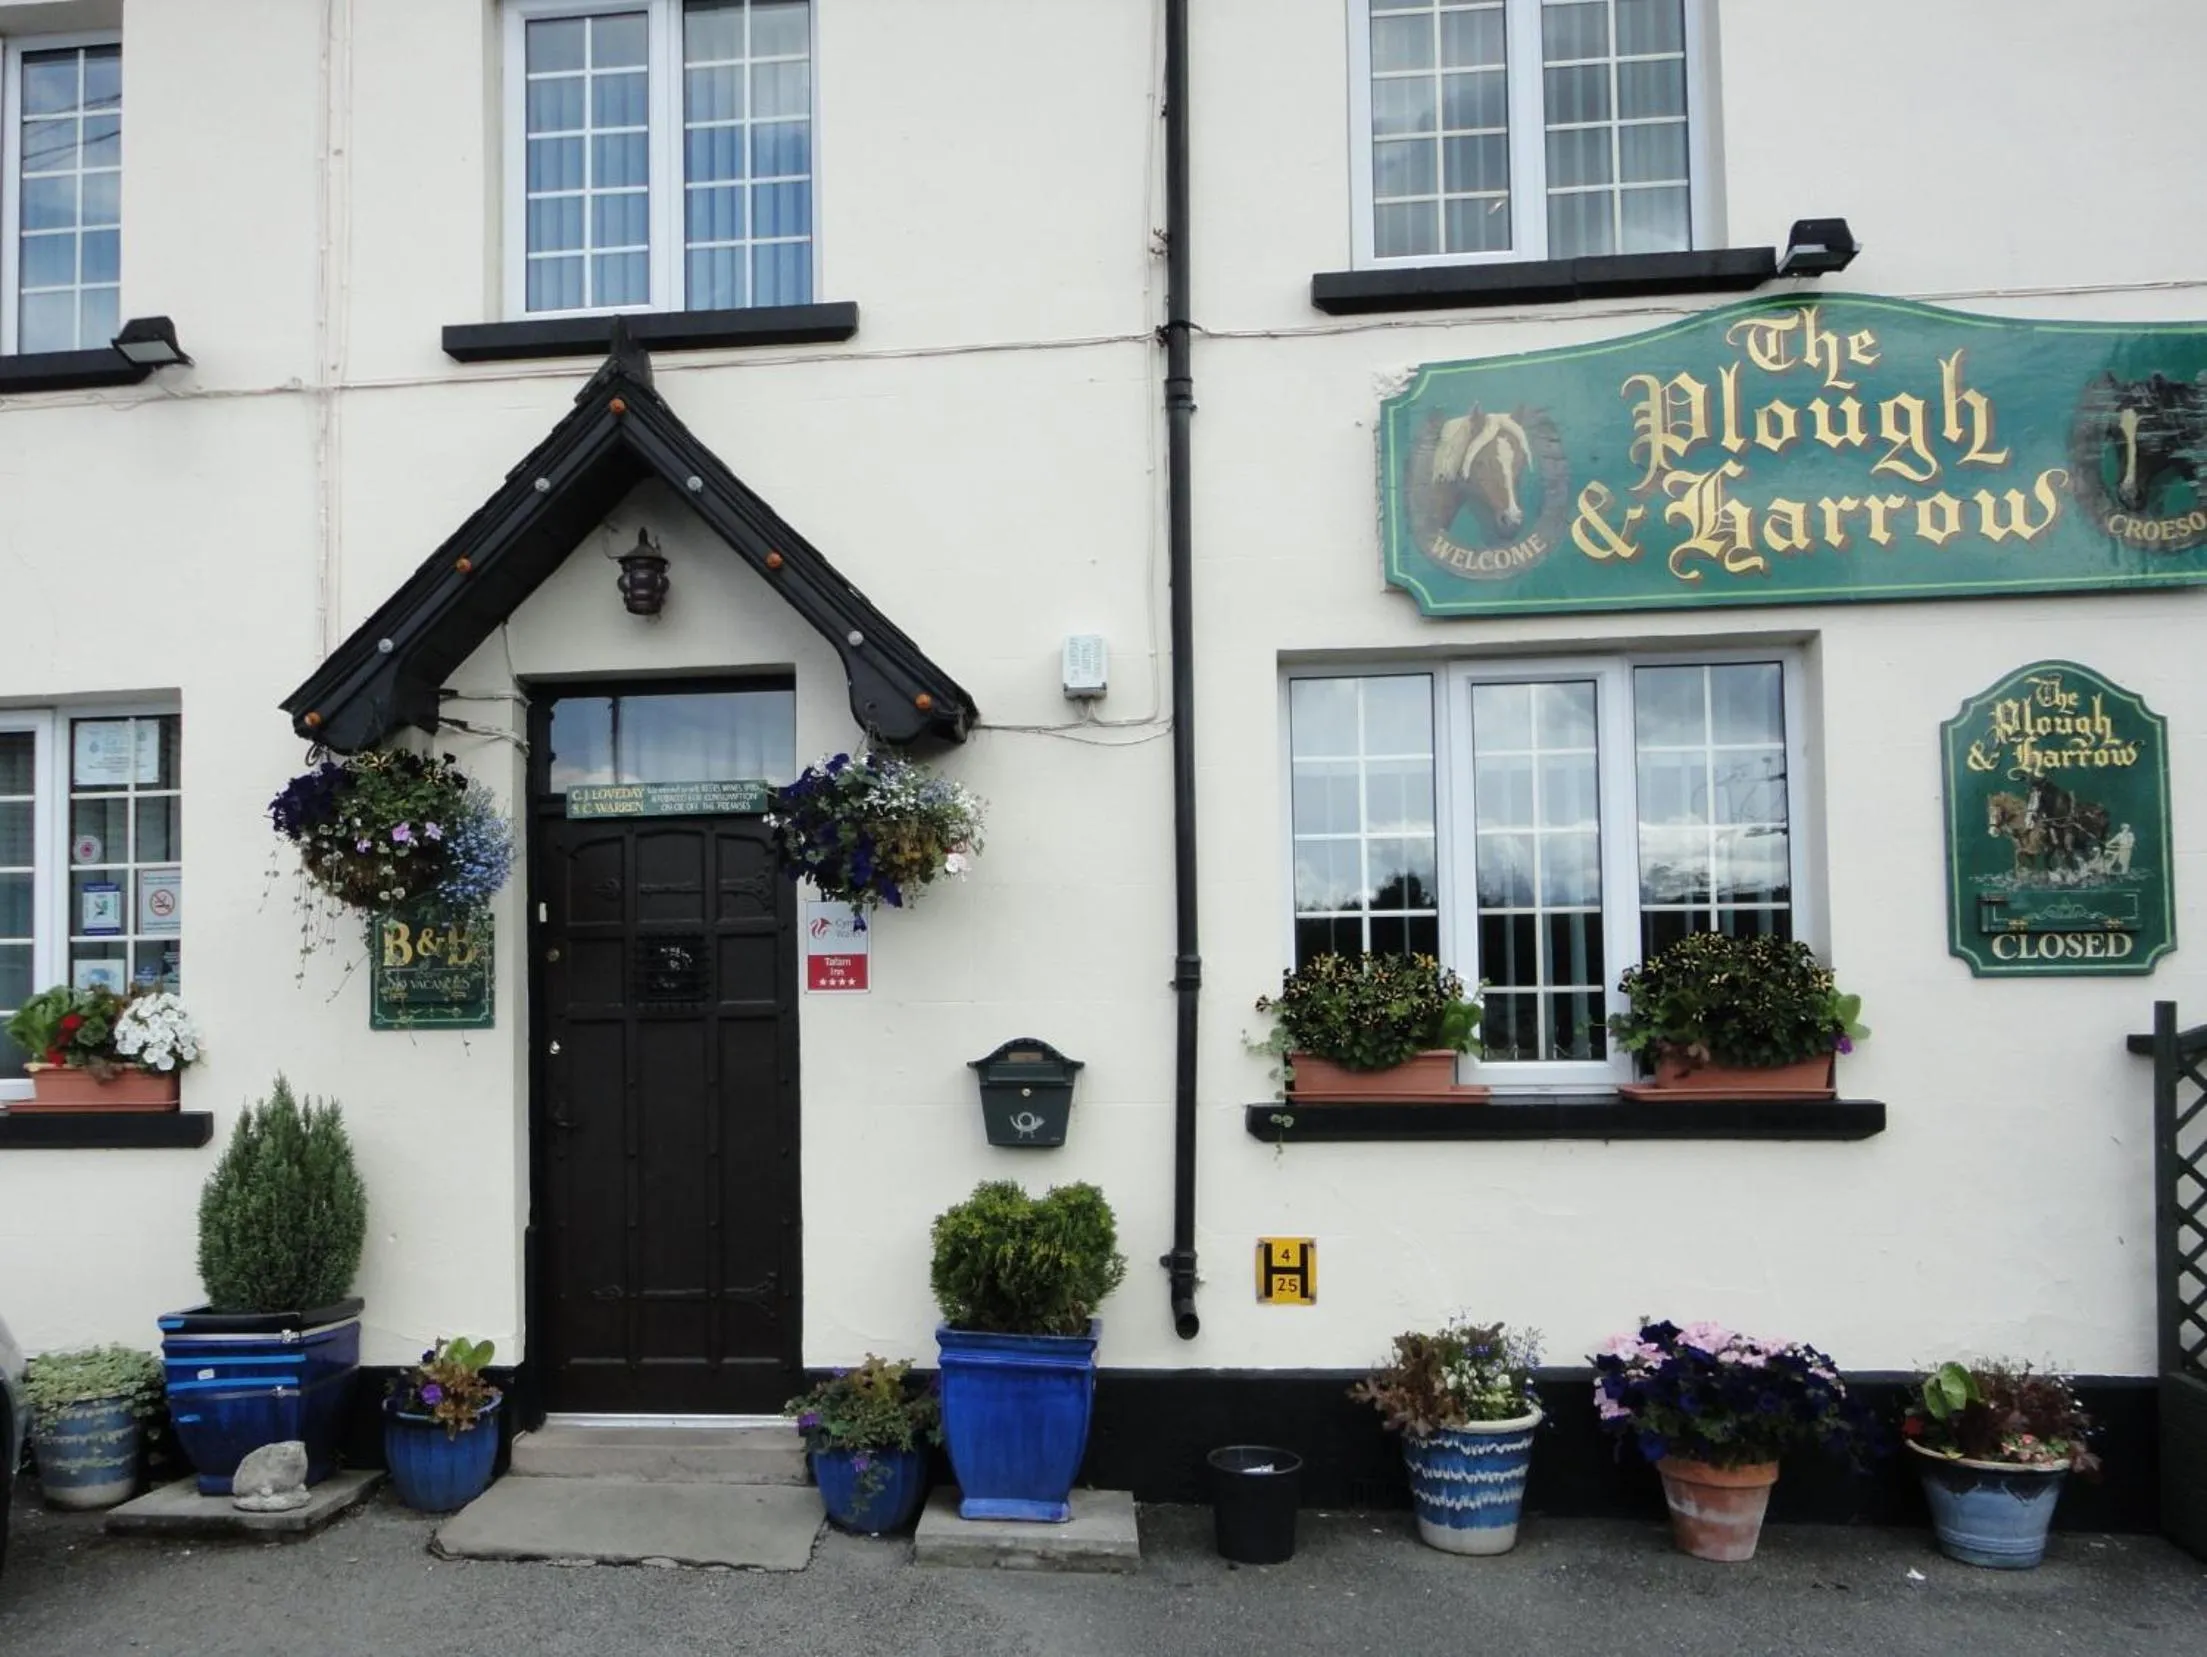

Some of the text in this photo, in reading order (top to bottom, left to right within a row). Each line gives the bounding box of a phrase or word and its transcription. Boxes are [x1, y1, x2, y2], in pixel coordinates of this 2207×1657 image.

[1726, 305, 1882, 390] The
[1620, 348, 2010, 491] Plough
[1571, 459, 2069, 580] & Harrow
[2107, 511, 2207, 541] CROESO
[1431, 533, 1548, 571] WELCOME
[2024, 673, 2080, 715] The
[1985, 691, 2123, 750] Plough
[1967, 735, 2145, 782] & Harrow
[382, 920, 413, 966] B
[416, 928, 445, 957] &
[1991, 932, 2133, 960] CLOSED
[1264, 1243, 1309, 1299] H
[1281, 1248, 1290, 1262] 4
[1278, 1278, 1298, 1293] 25
